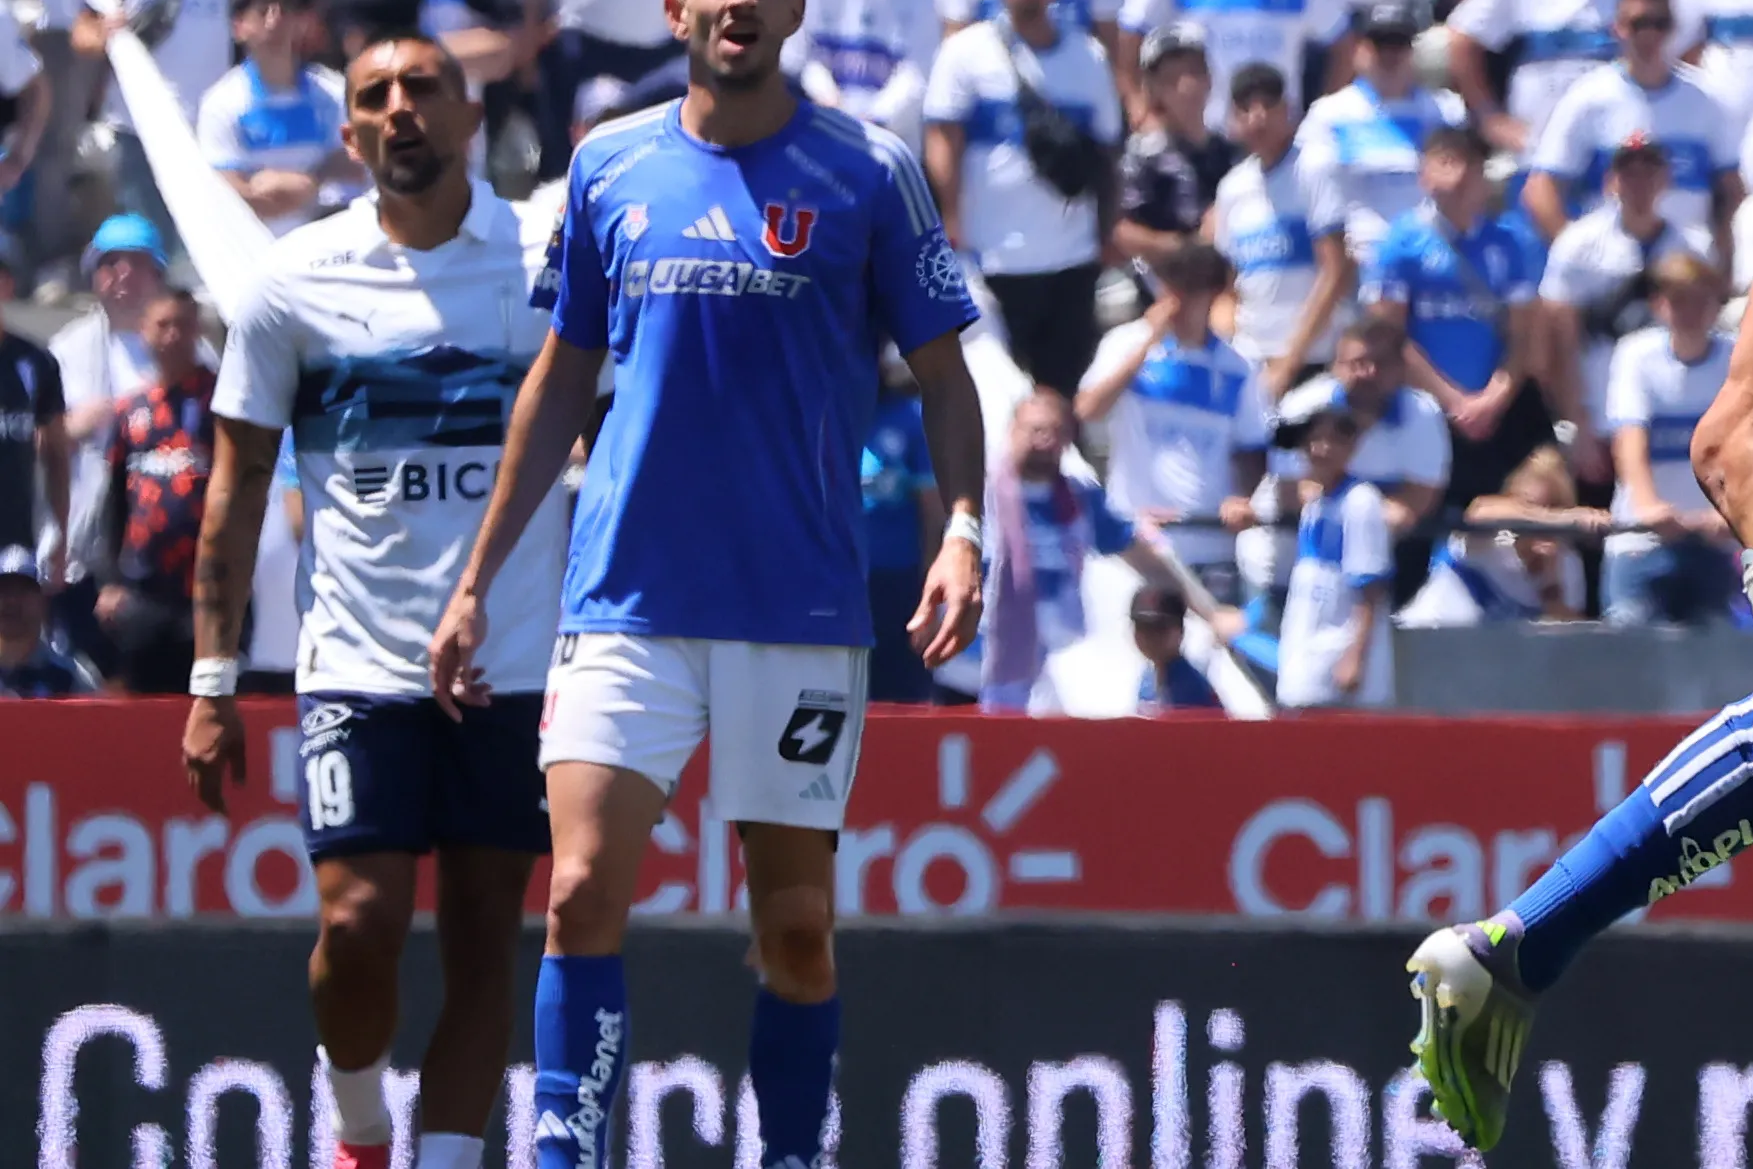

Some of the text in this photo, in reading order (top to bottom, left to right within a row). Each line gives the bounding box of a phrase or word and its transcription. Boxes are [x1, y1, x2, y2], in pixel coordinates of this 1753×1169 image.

[402, 461, 501, 502] BIC
[0, 780, 323, 919] laro
[305, 750, 356, 831] 19
[630, 797, 998, 917] lro
[1229, 797, 1648, 922] Clar
